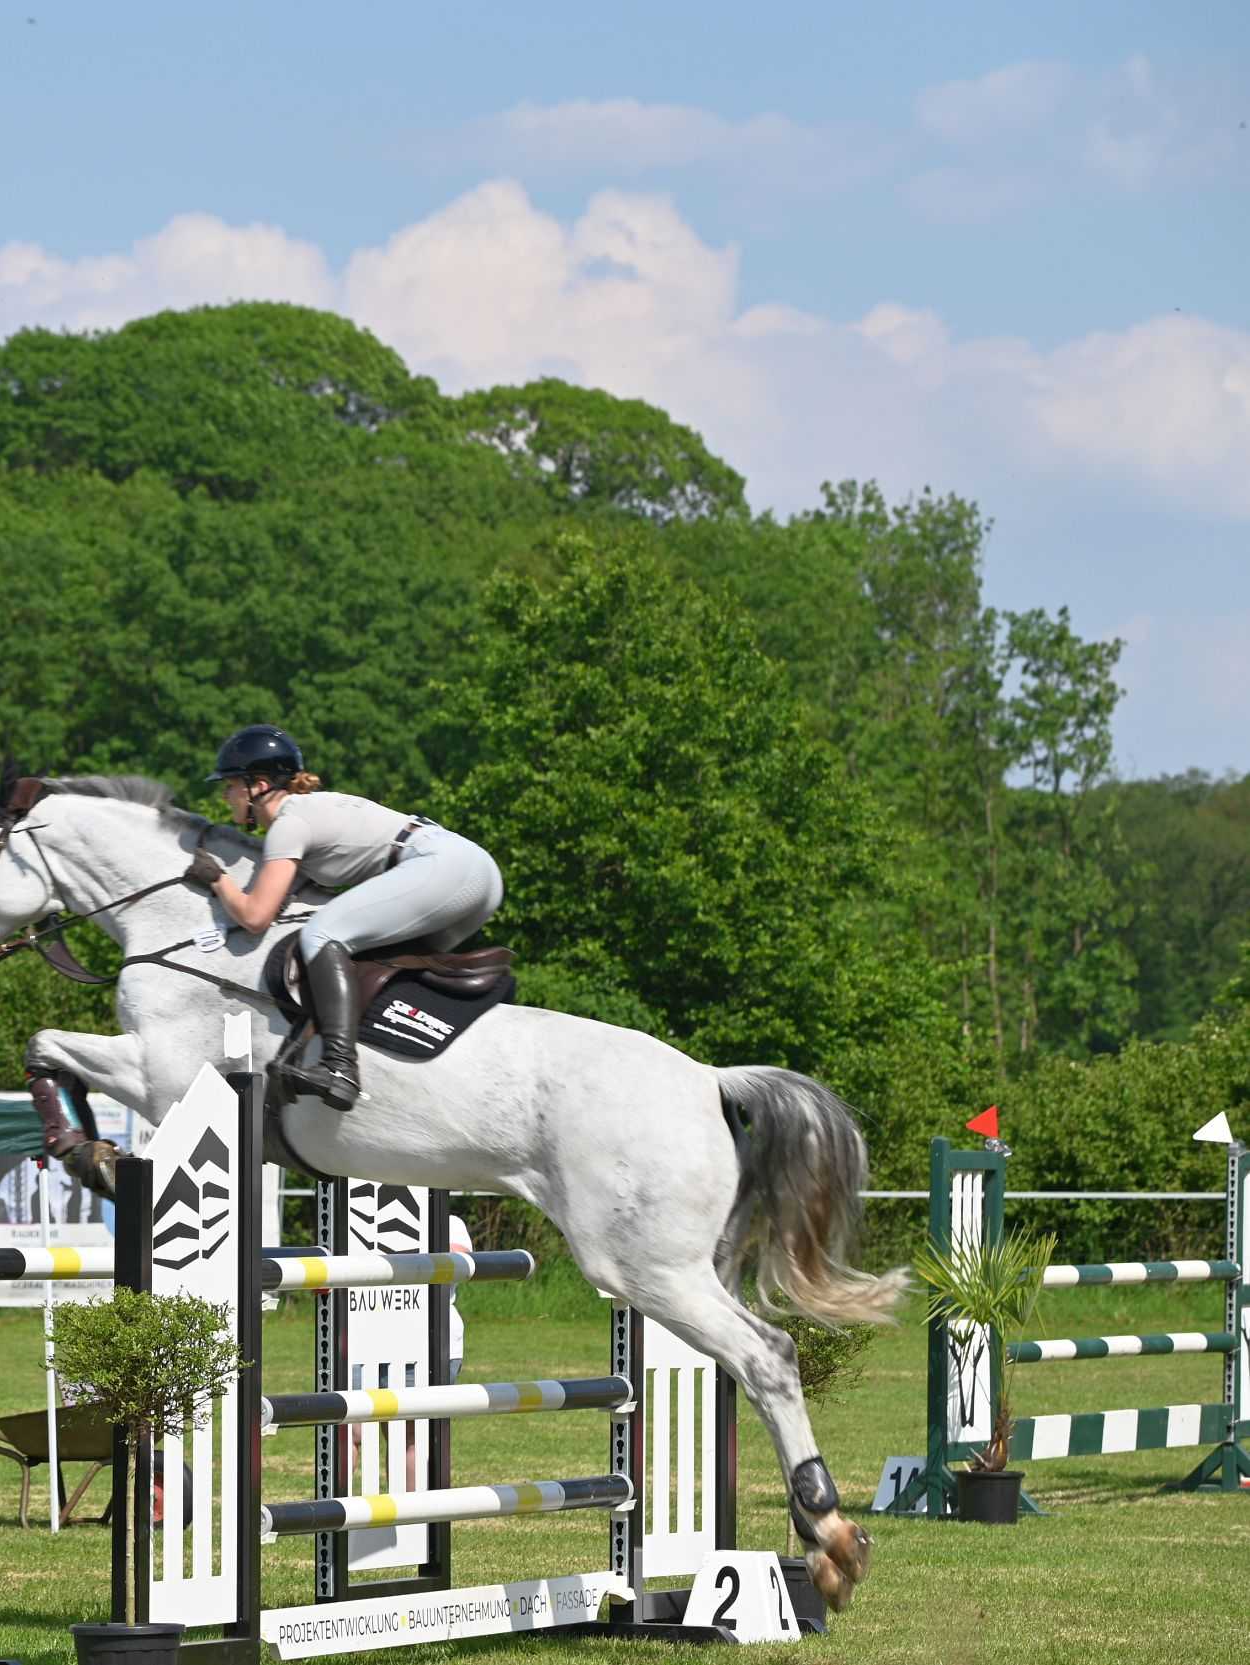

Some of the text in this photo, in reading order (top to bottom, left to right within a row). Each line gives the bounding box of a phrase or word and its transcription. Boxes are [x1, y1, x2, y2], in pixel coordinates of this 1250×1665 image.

[279, 1588, 598, 1645] PROJEKTENTWICKLUNG BAUUNTERNEHMUNG DACH FASSADE
[711, 1565, 741, 1631] 2
[769, 1566, 790, 1631] 2
